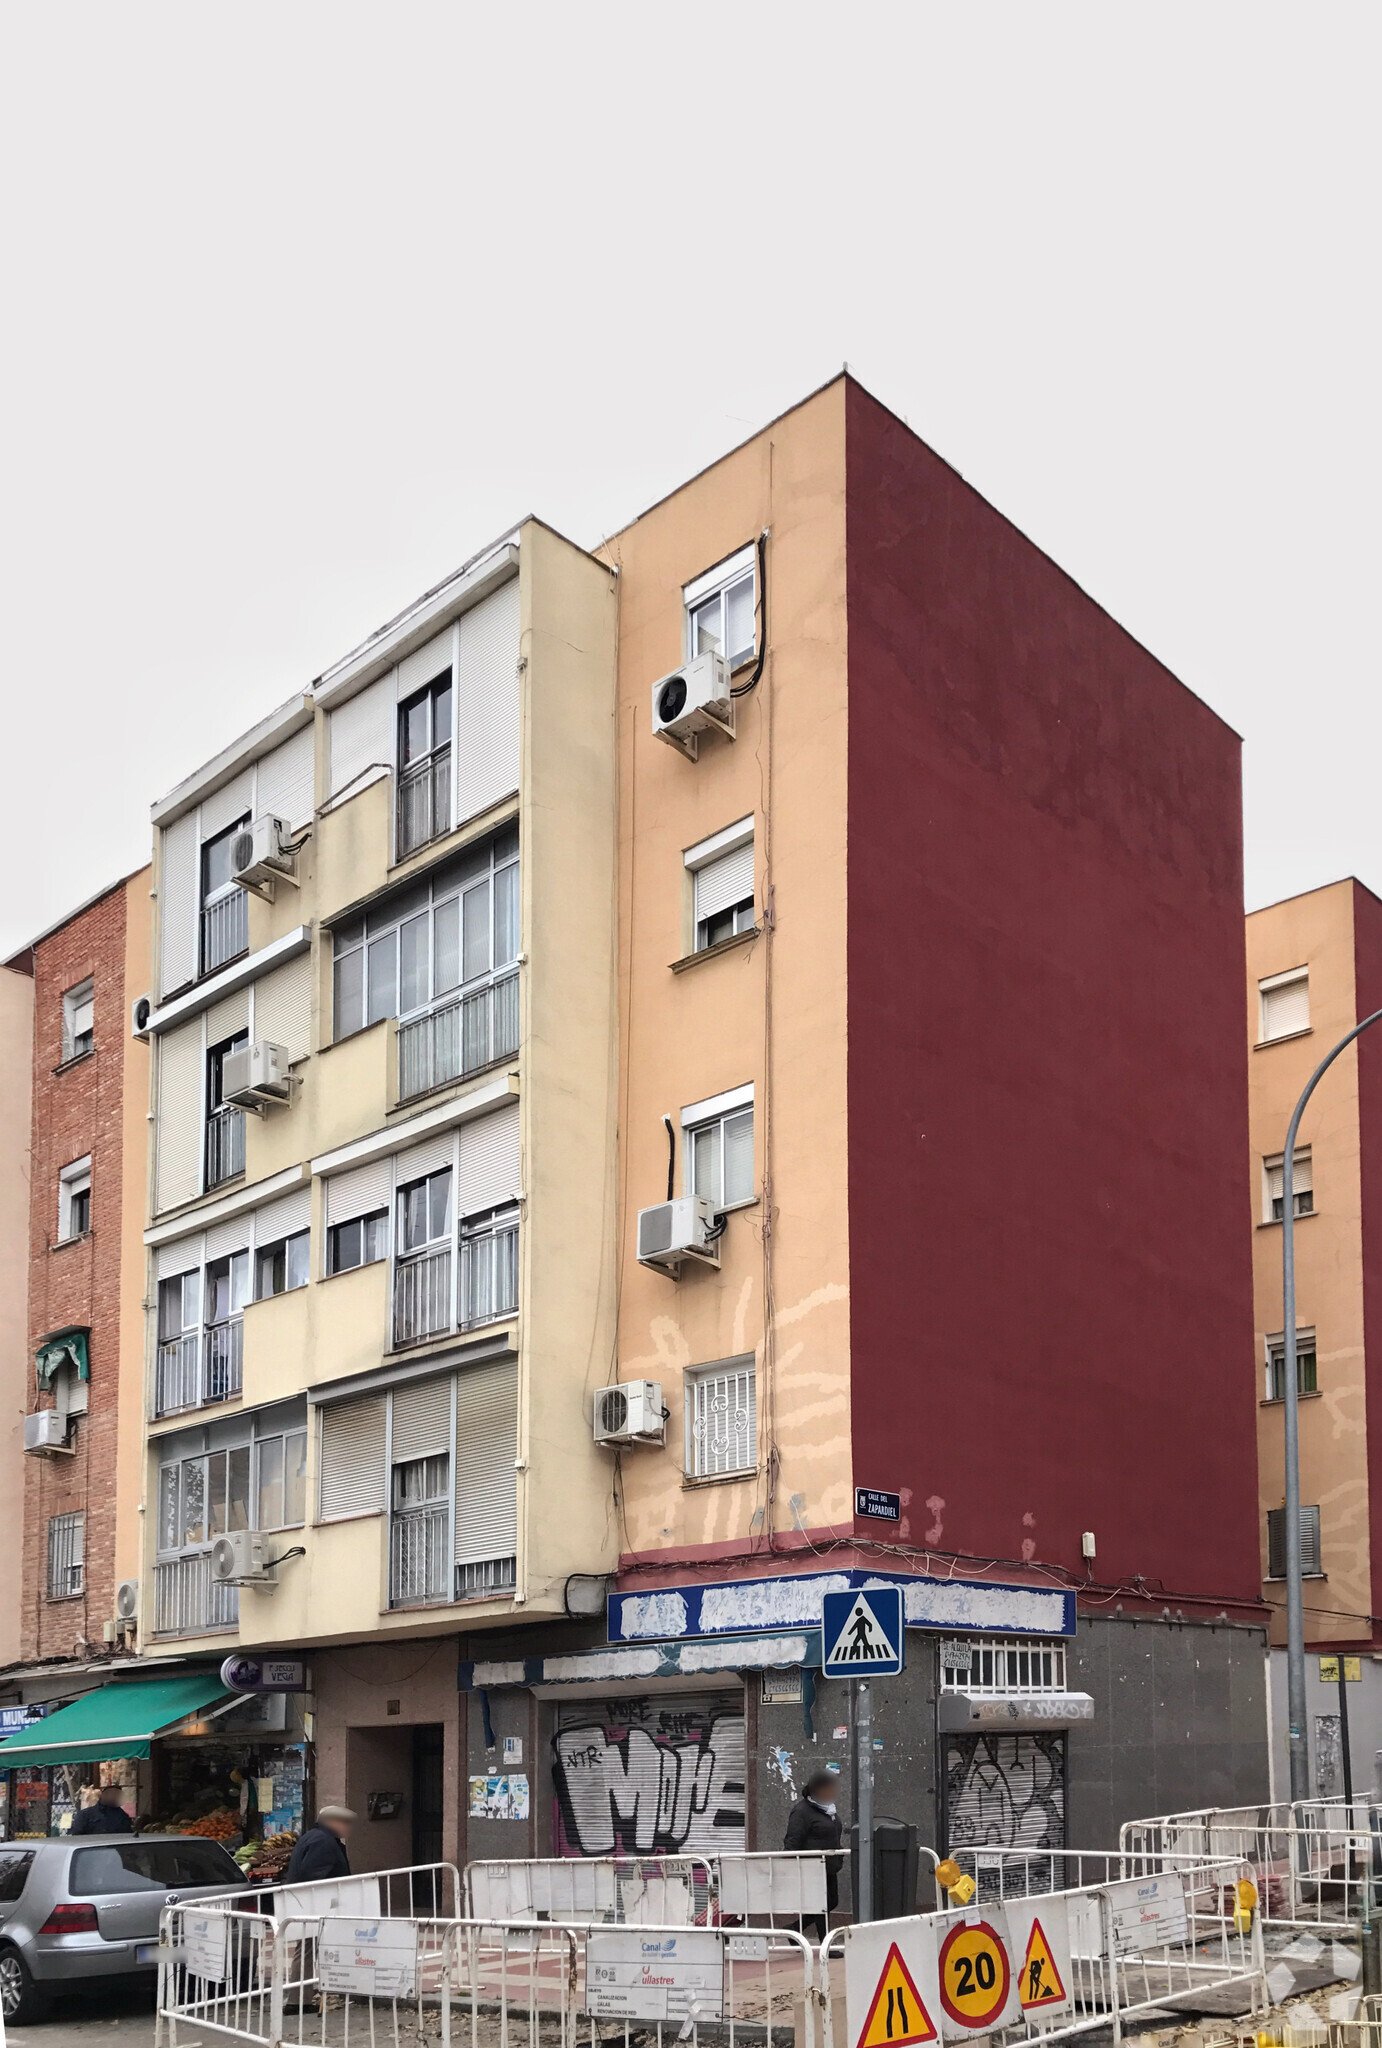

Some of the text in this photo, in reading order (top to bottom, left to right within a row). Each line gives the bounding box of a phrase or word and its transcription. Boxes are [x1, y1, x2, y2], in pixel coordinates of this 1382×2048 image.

[867, 1492, 889, 1503] CALLE DEL
[867, 1503, 897, 1518] ZAPARDIEL
[271, 1672, 295, 1682] VEGA
[641, 1942, 661, 1952] Canal
[954, 1951, 996, 1998] 20
[642, 1975, 675, 1985] ullastres
